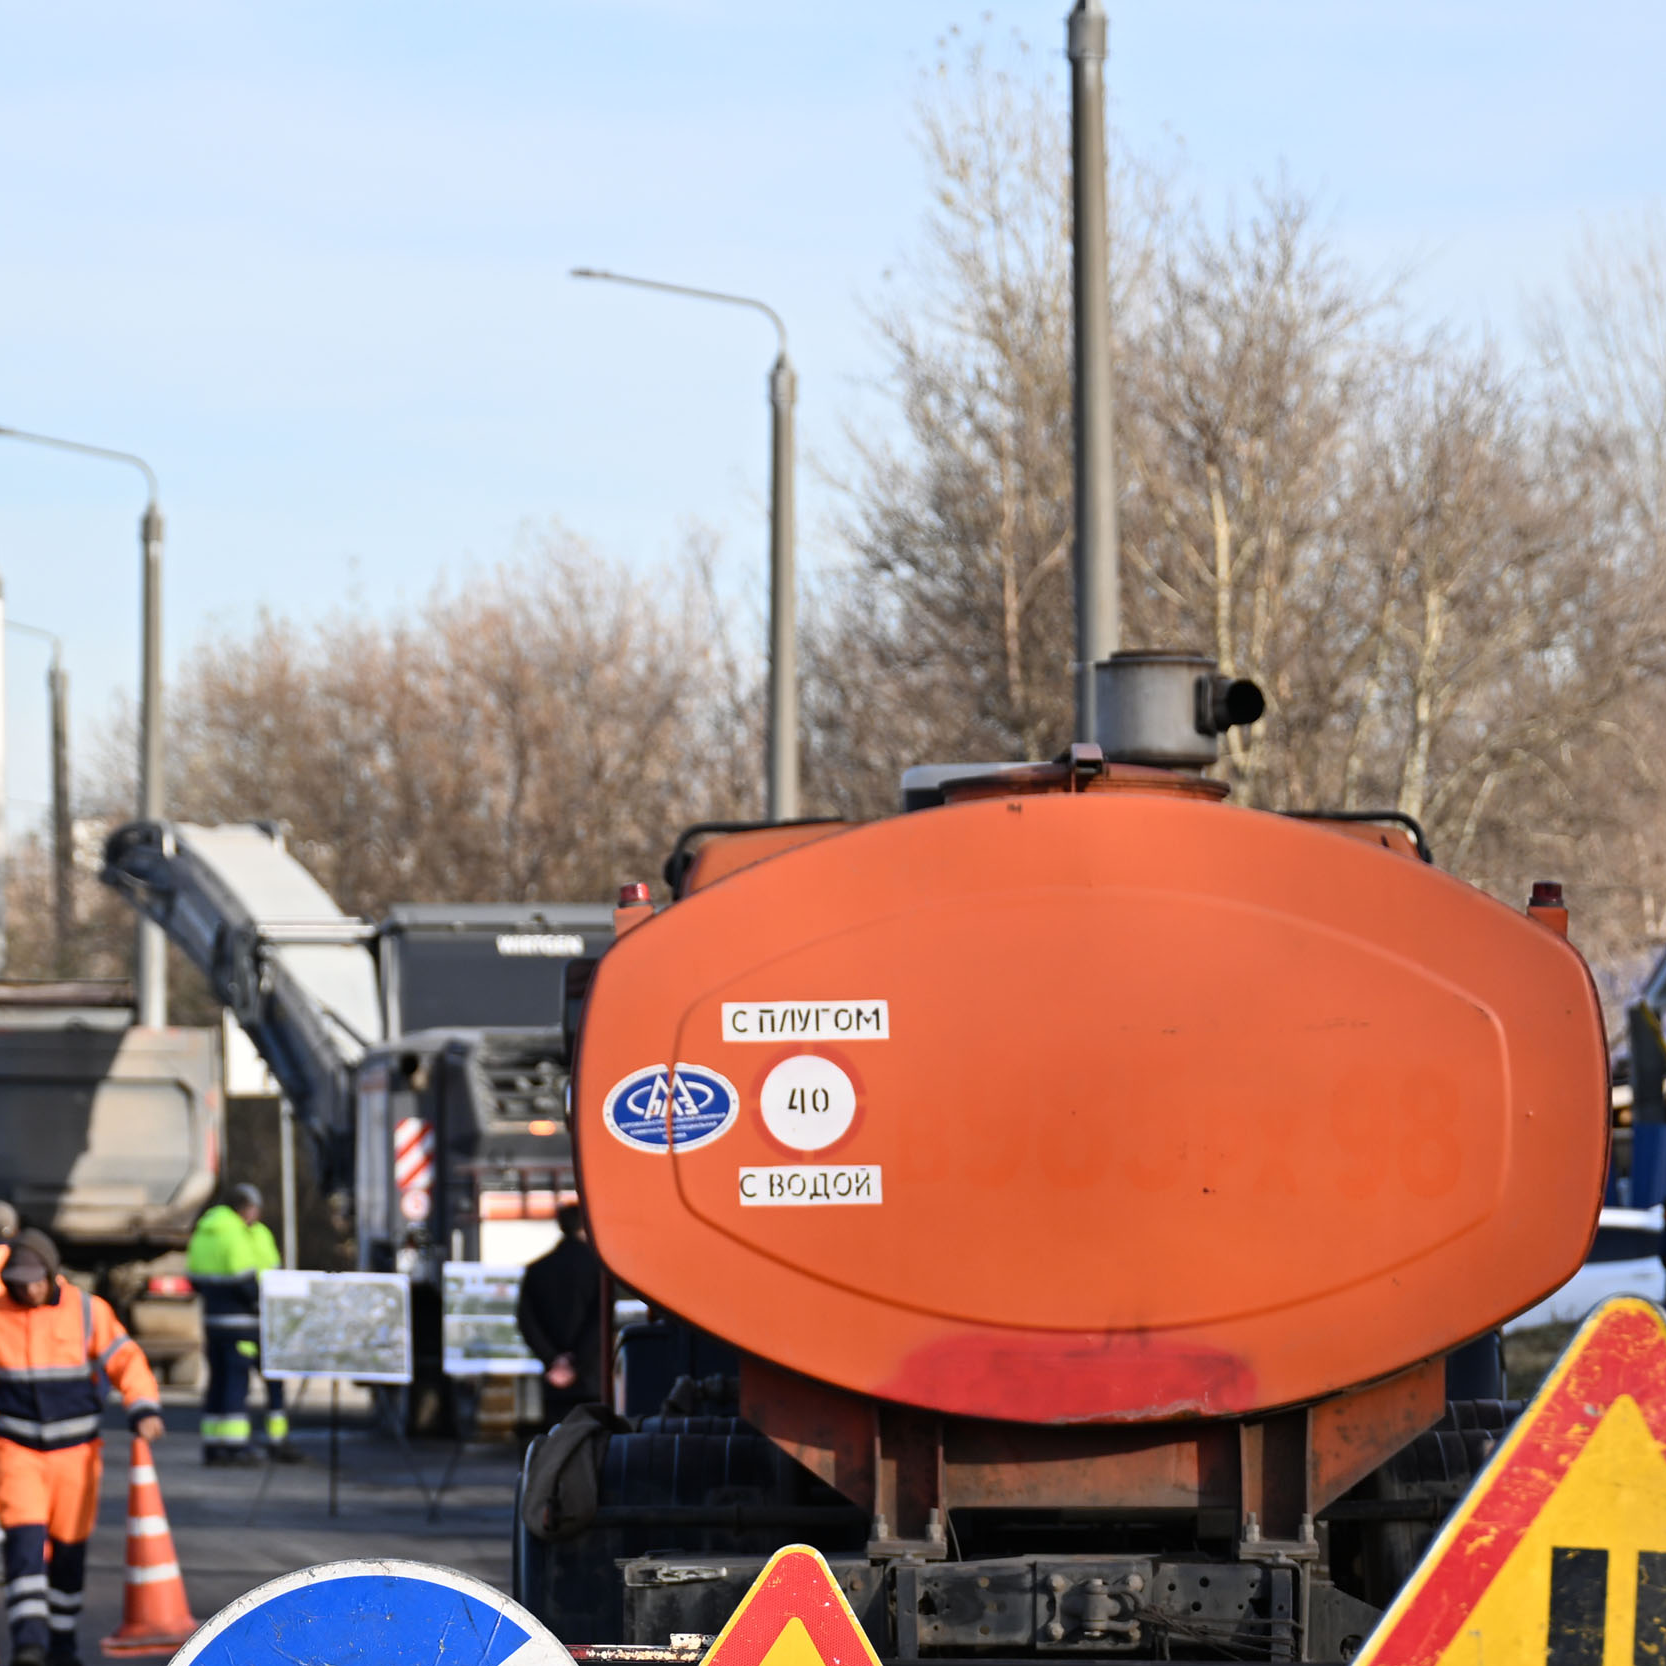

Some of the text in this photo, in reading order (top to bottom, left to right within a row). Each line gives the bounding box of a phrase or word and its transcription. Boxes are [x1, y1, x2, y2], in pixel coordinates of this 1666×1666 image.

[732, 1007, 881, 1034] С ПЛУГОМ
[788, 1087, 830, 1114] 40
[739, 1168, 871, 1200] С ВОДОЙ
